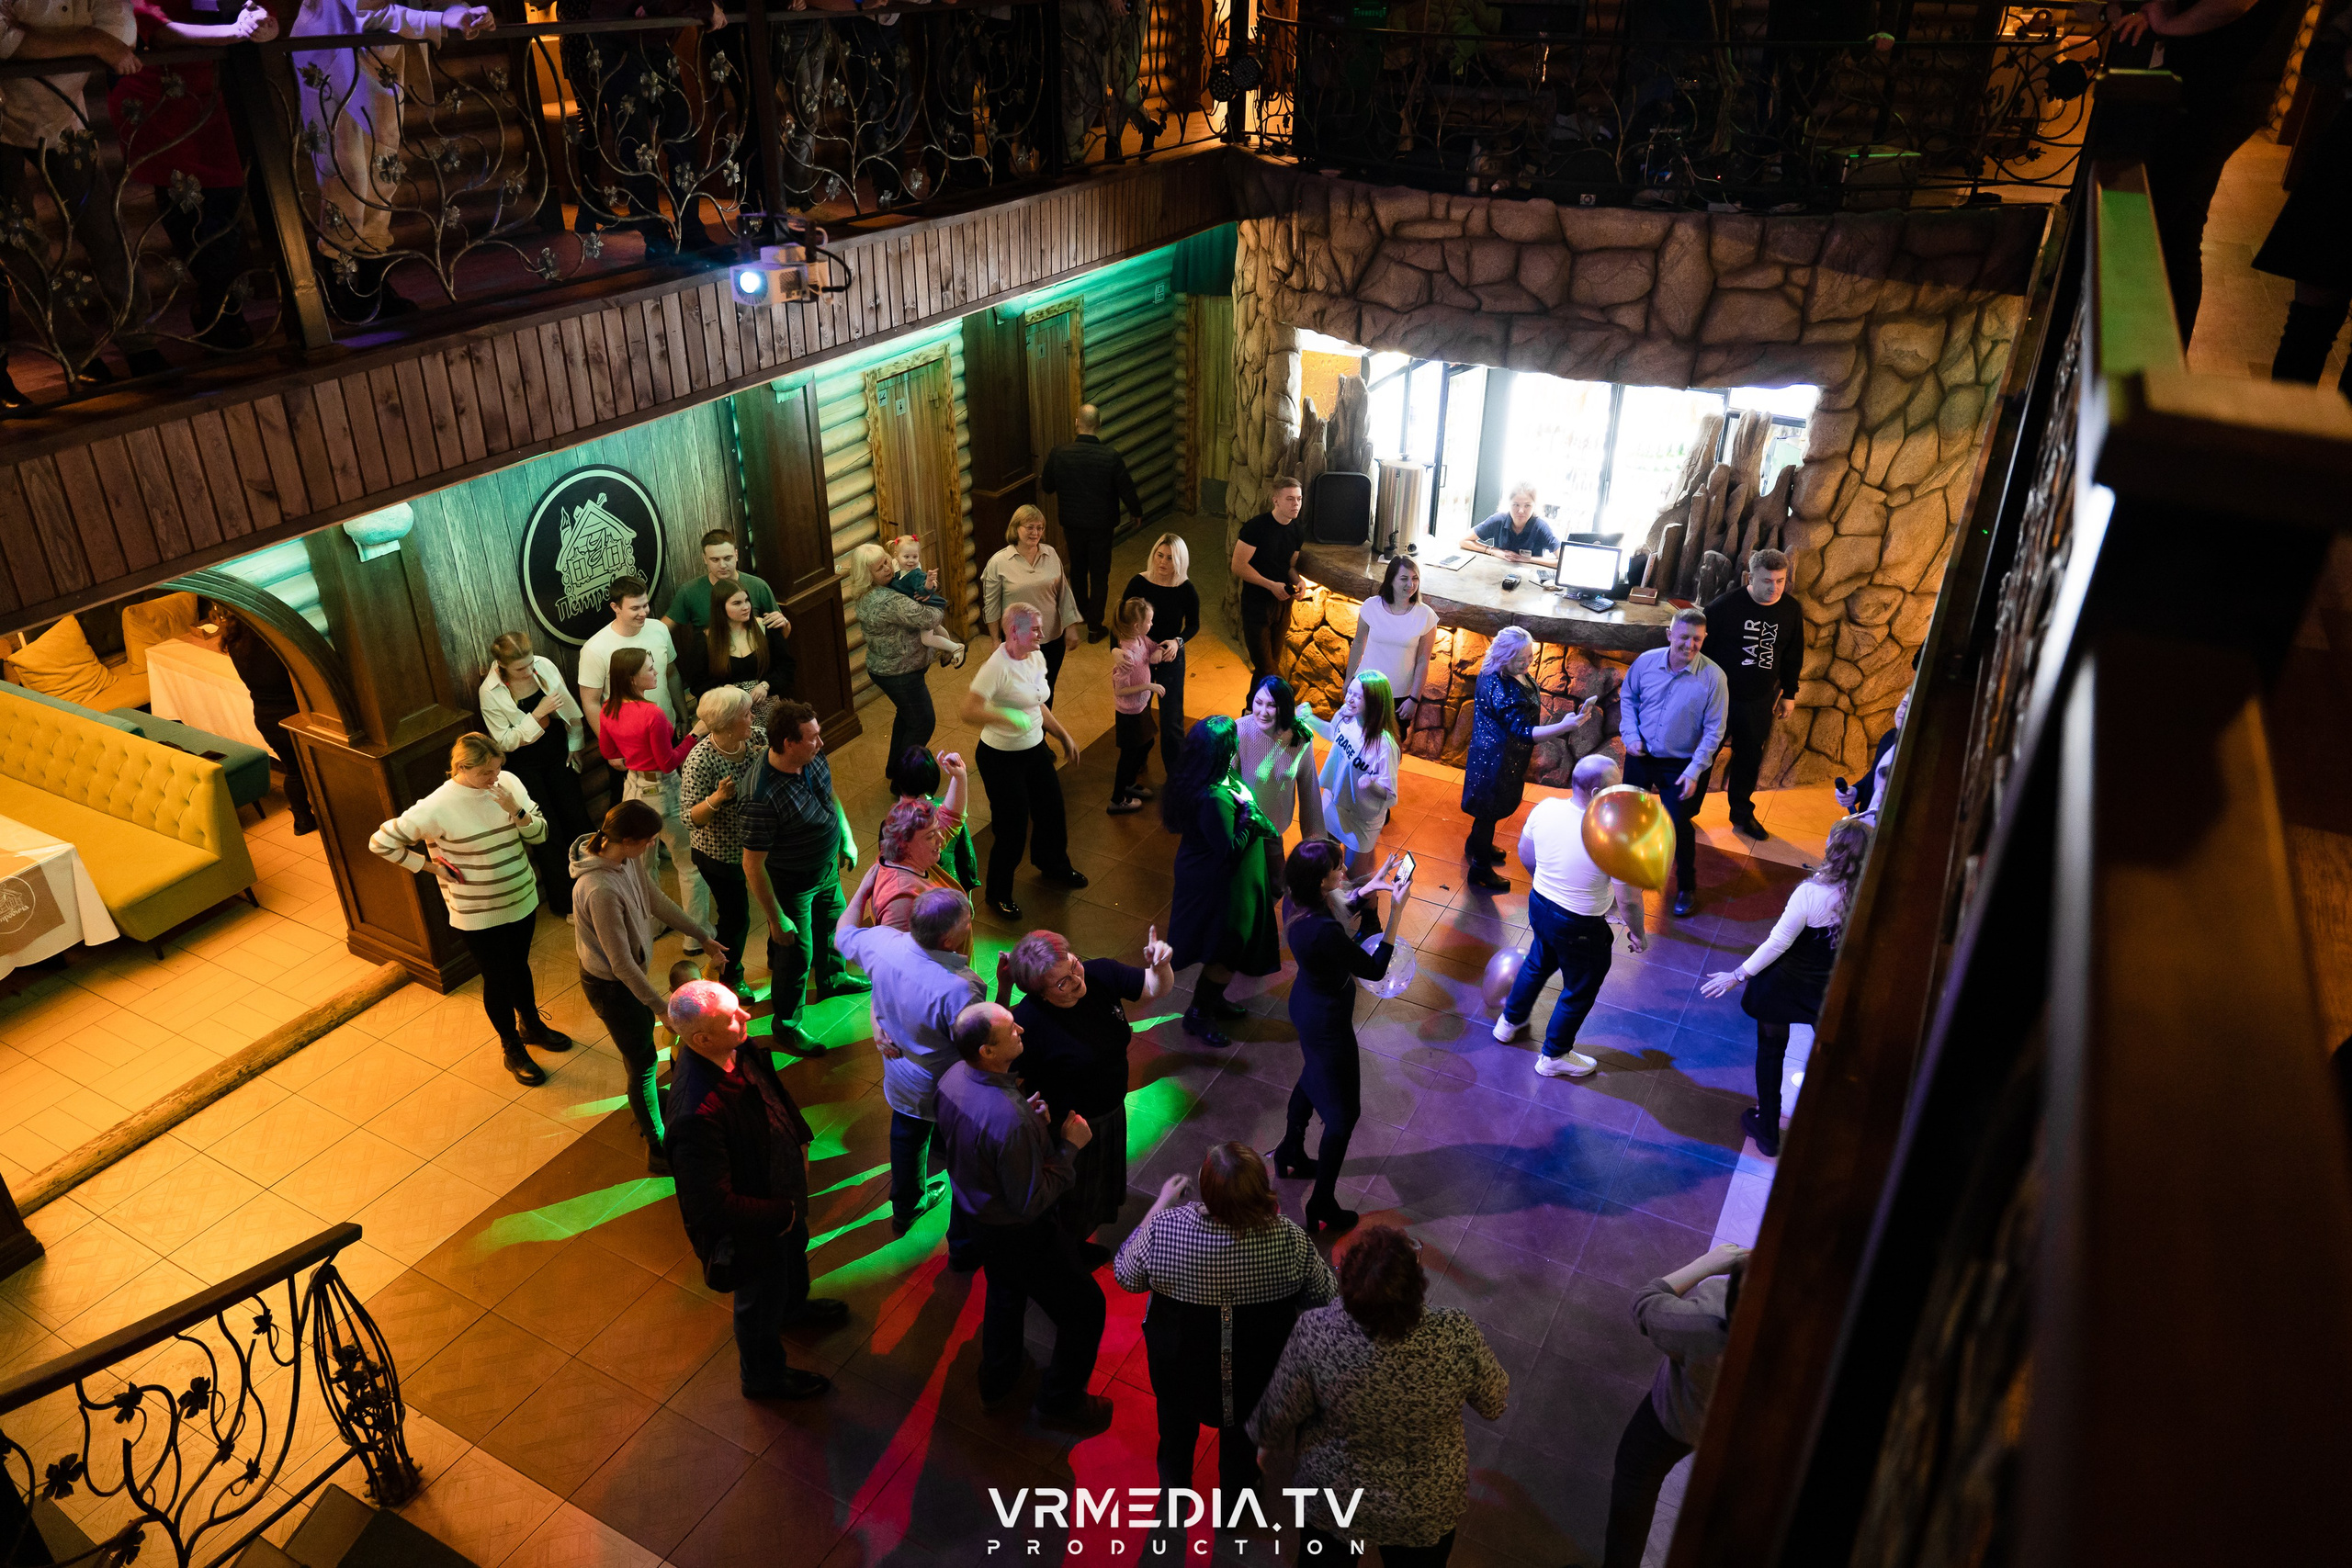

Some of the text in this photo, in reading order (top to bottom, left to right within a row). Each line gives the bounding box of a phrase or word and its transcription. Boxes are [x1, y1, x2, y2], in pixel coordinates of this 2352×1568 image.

[1758, 621, 1779, 670] MAX
[1335, 733, 1379, 775] RAGE QU
